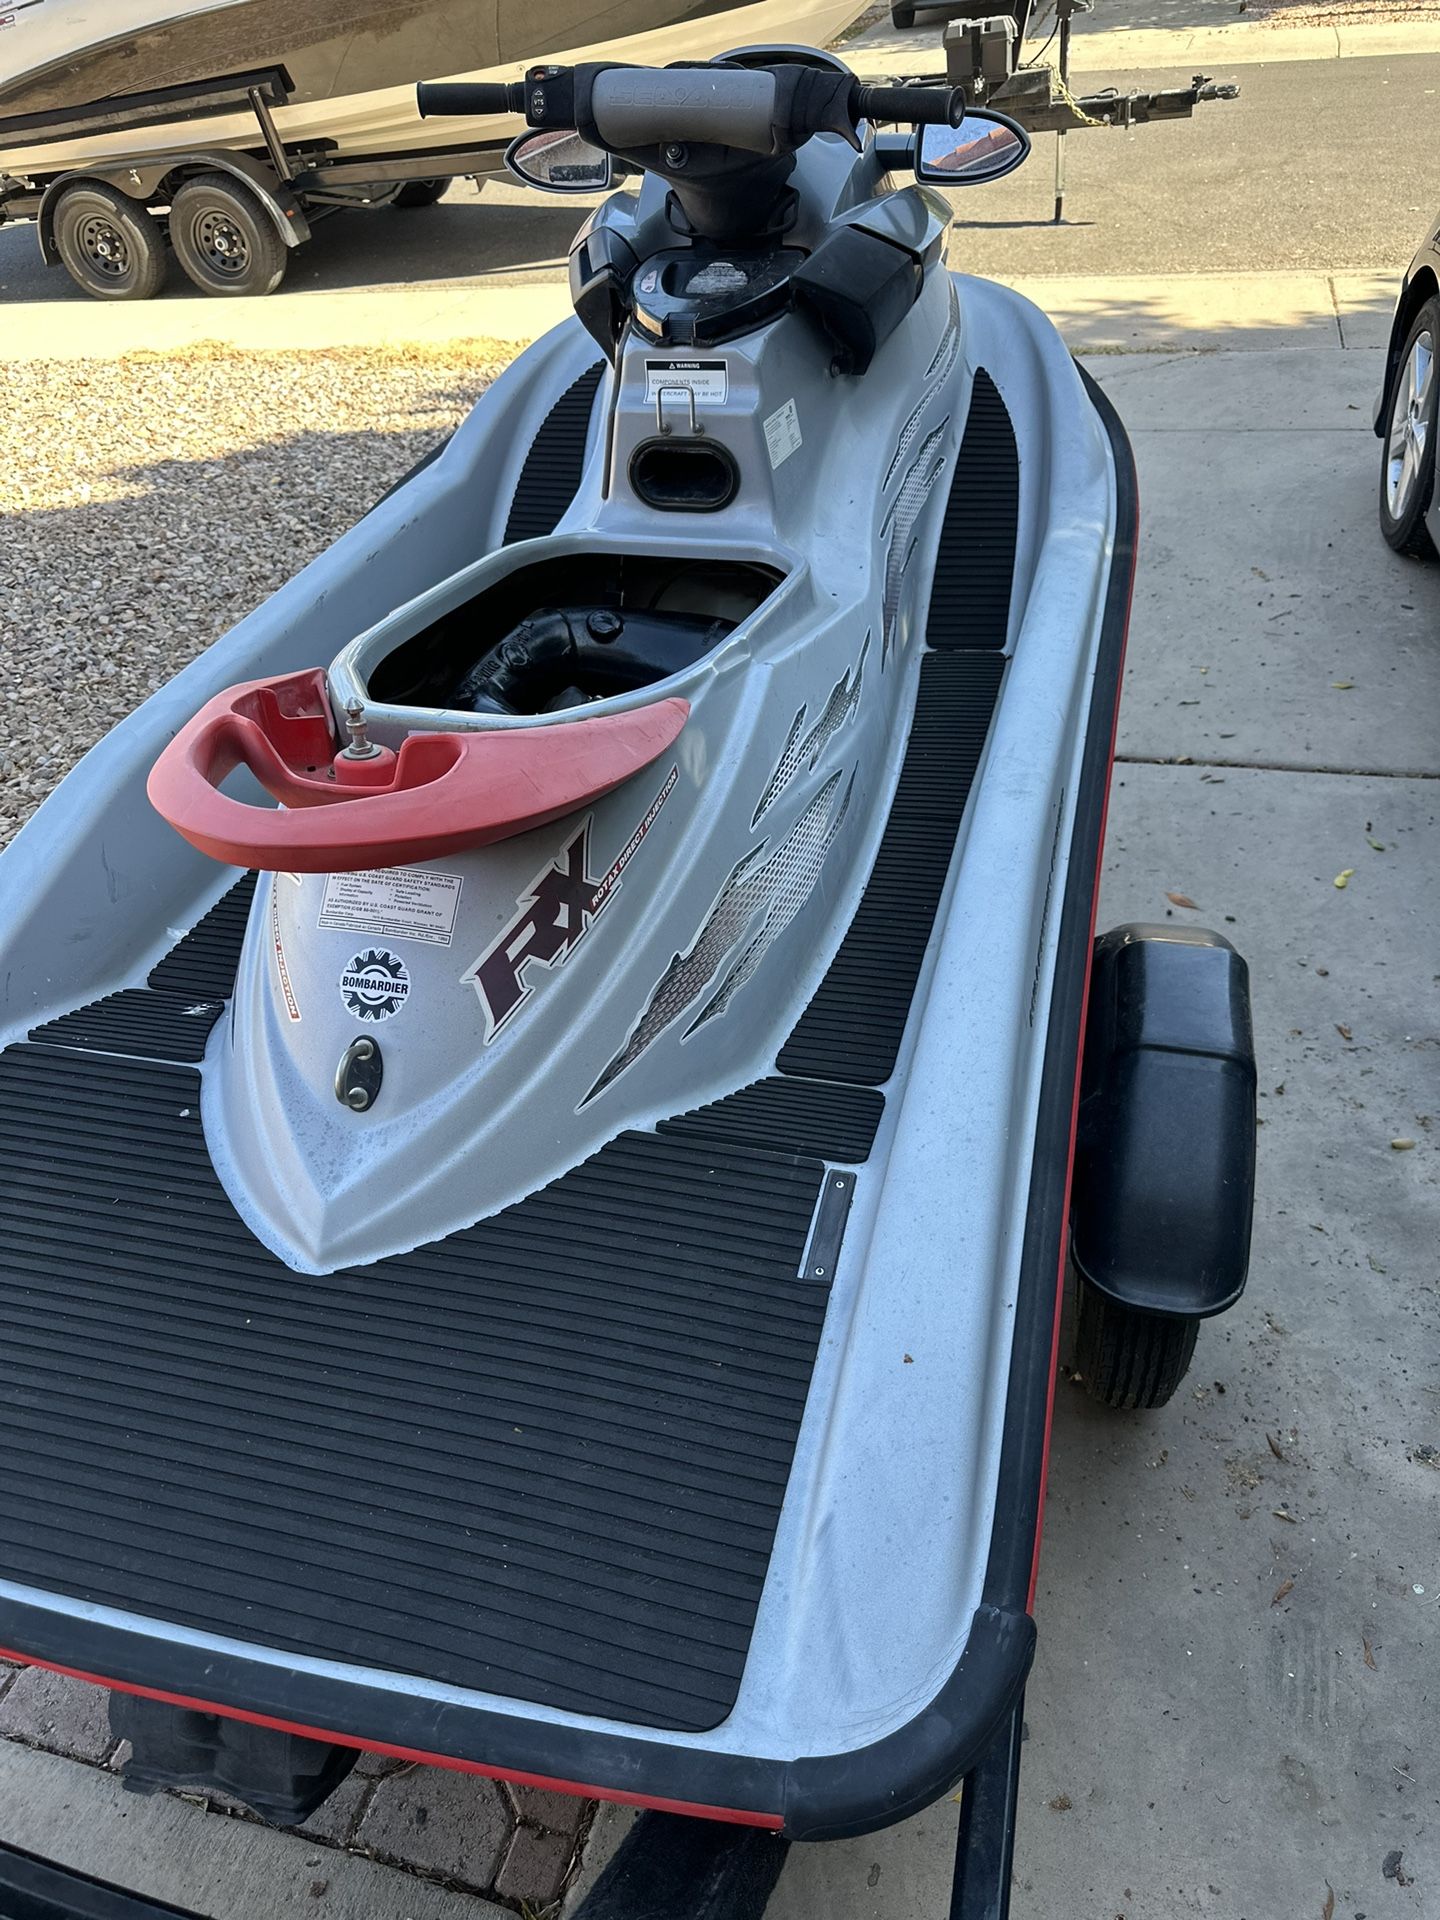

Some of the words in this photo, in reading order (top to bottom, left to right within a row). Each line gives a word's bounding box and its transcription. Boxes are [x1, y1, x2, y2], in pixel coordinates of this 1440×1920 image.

[592, 867, 618, 907] ROTAX
[619, 827, 644, 870] DIRECT
[644, 771, 676, 830] INJECTION
[423, 881, 455, 889] STANDARDS
[334, 897, 361, 905] AUTHORIZED
[278, 950, 298, 1015] INJECTION
[342, 976, 408, 994] BOMBARDIER
